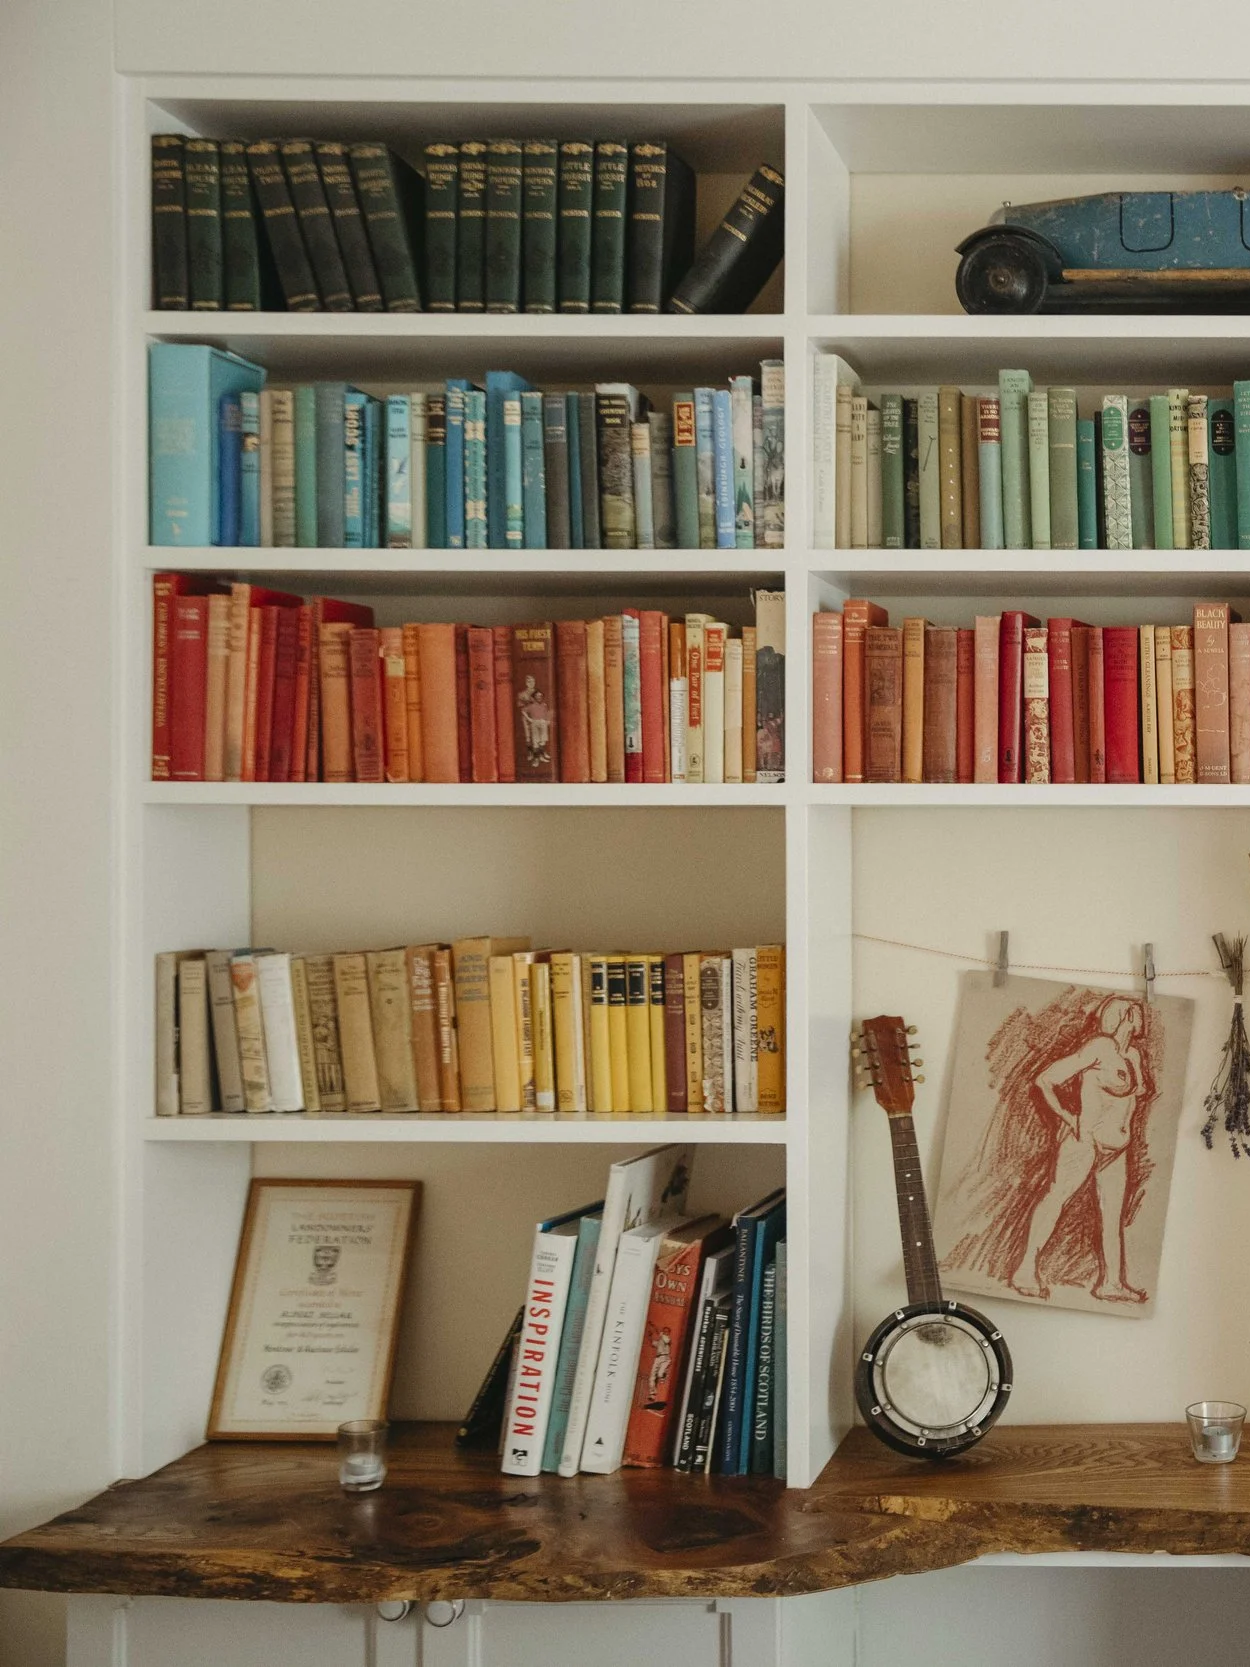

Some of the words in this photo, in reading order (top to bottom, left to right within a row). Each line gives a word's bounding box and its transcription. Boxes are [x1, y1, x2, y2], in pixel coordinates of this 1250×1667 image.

[1196, 609, 1225, 617] BLACK
[1196, 620, 1226, 629] BEAUTY
[761, 1301, 774, 1343] BIRDS
[512, 1278, 555, 1436] INSPIRATION
[760, 1345, 772, 1363] OF
[755, 1365, 771, 1441] SCOTLAND
